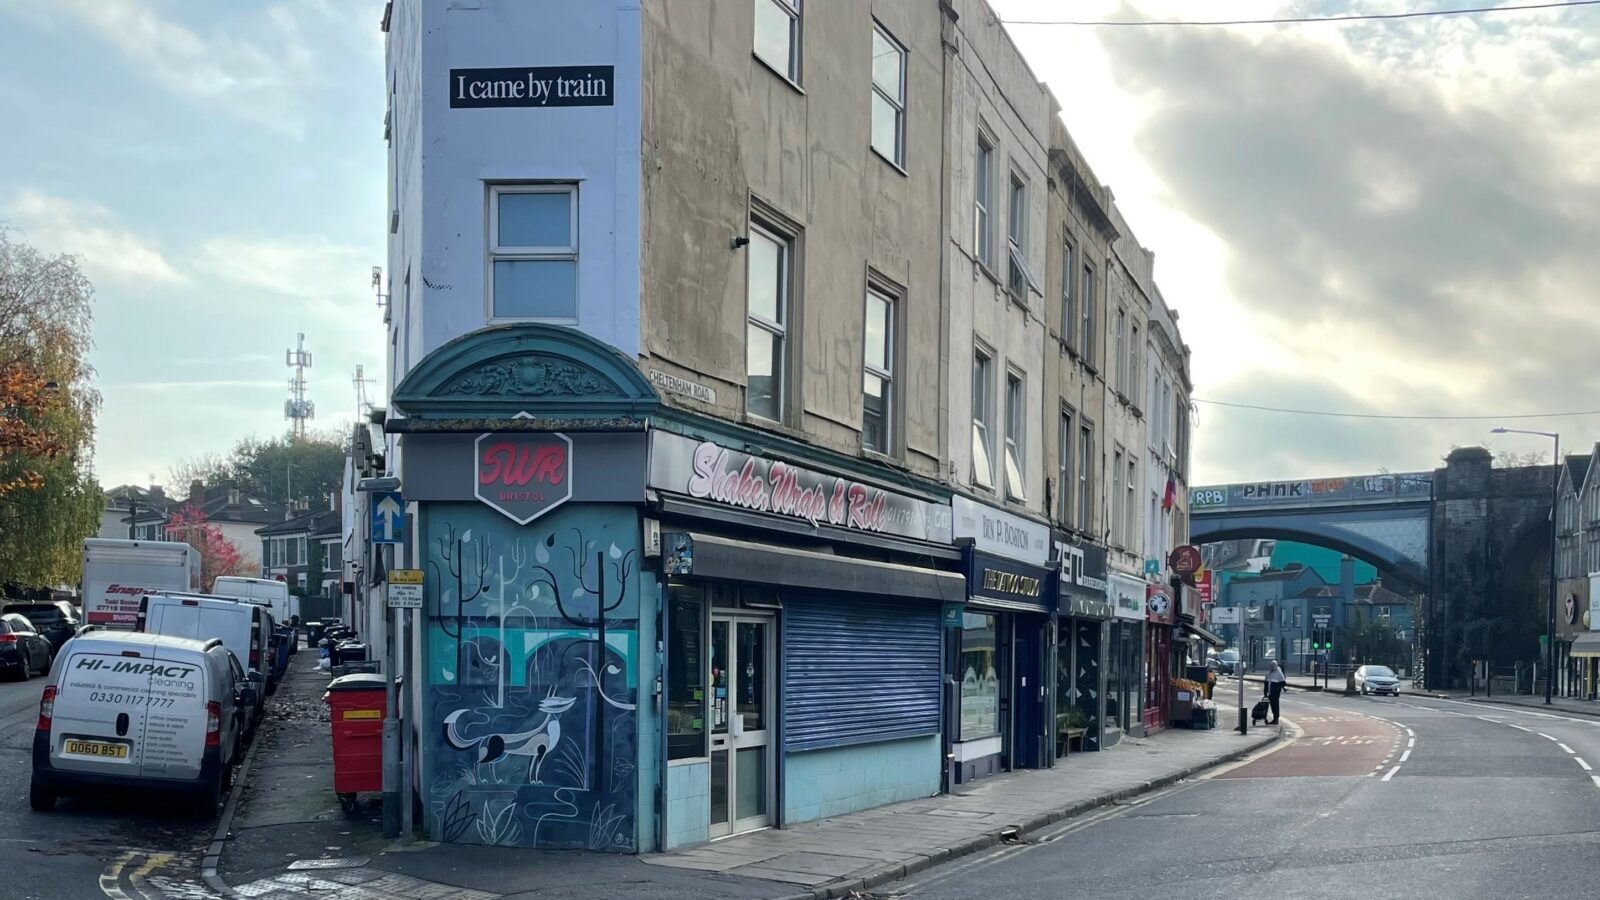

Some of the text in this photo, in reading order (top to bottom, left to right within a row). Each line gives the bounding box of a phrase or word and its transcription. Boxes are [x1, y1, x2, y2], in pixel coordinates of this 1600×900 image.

[456, 72, 608, 105] I came by train
[649, 370, 710, 400] CHELTENHAM ROAD
[479, 442, 566, 487] SWR
[499, 491, 545, 502] BRISTOL
[688, 442, 769, 512] Shake,
[769, 461, 826, 529] Wrap
[828, 478, 845, 525] &
[847, 482, 887, 532] Roll
[1195, 489, 1224, 505] RPB
[1004, 521, 1029, 551] BOSTON
[75, 658, 196, 679] HI-IMPACT
[146, 677, 195, 691] cleaning
[89, 691, 123, 704] 0330
[101, 745, 123, 757] BST
